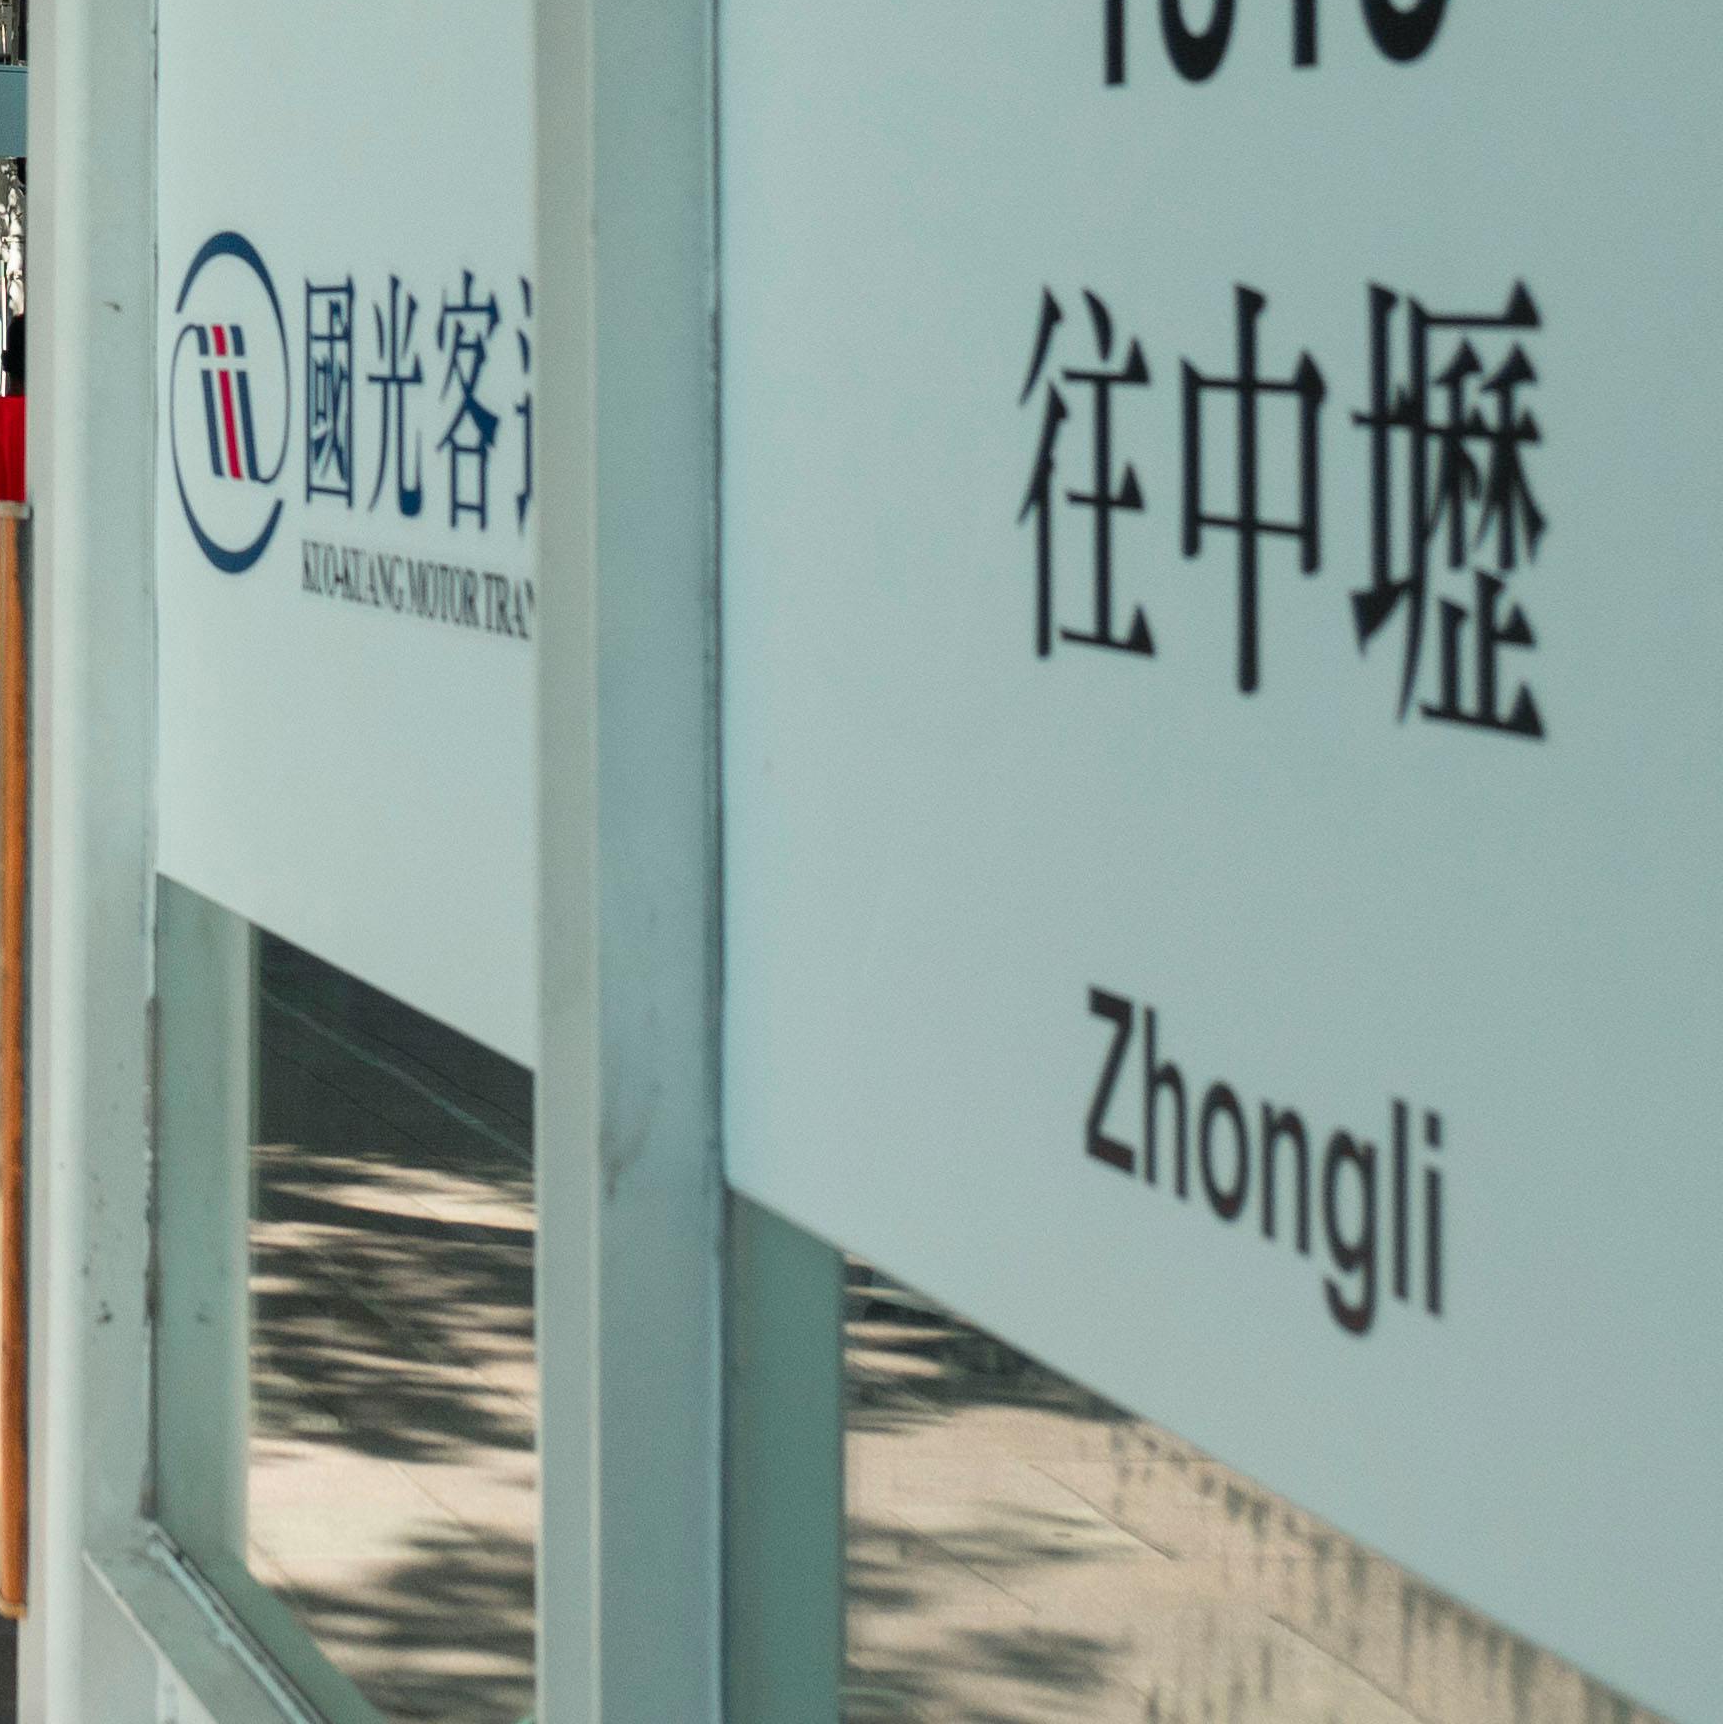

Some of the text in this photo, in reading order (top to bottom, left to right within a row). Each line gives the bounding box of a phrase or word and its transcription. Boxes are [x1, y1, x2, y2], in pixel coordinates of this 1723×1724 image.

[407, 556, 479, 628] MOTOR
[1019, 280, 1548, 742] 往中壢
[1084, 983, 1445, 1339] Zhongli
